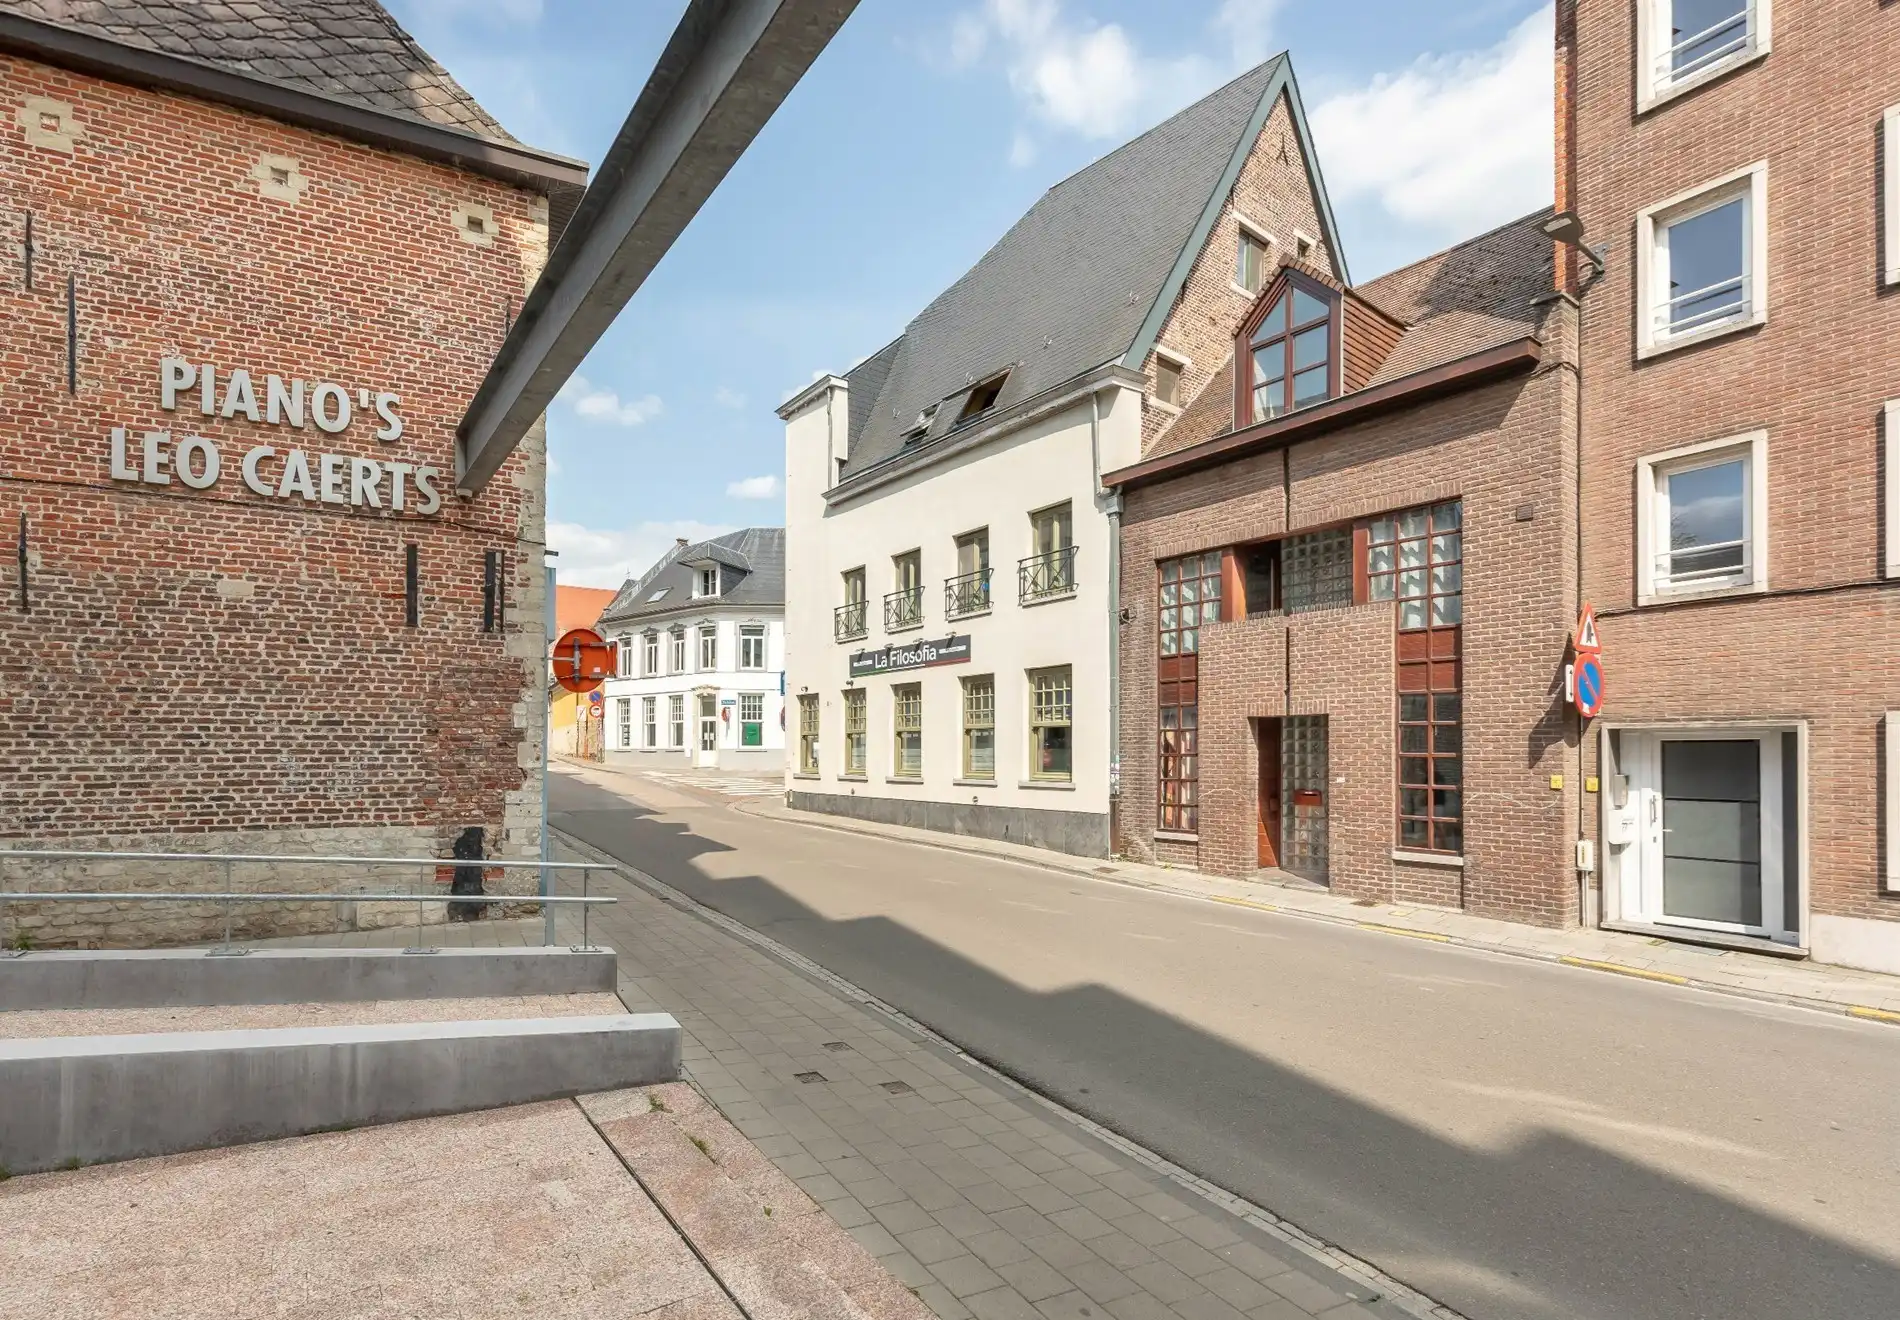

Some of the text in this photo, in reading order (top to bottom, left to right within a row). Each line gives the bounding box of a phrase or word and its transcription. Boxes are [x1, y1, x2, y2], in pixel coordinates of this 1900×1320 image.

[160, 357, 403, 442] PIANO'S
[111, 427, 441, 515] LEO CAERTS
[874, 653, 888, 669] La
[890, 645, 937, 666] Filosofia
